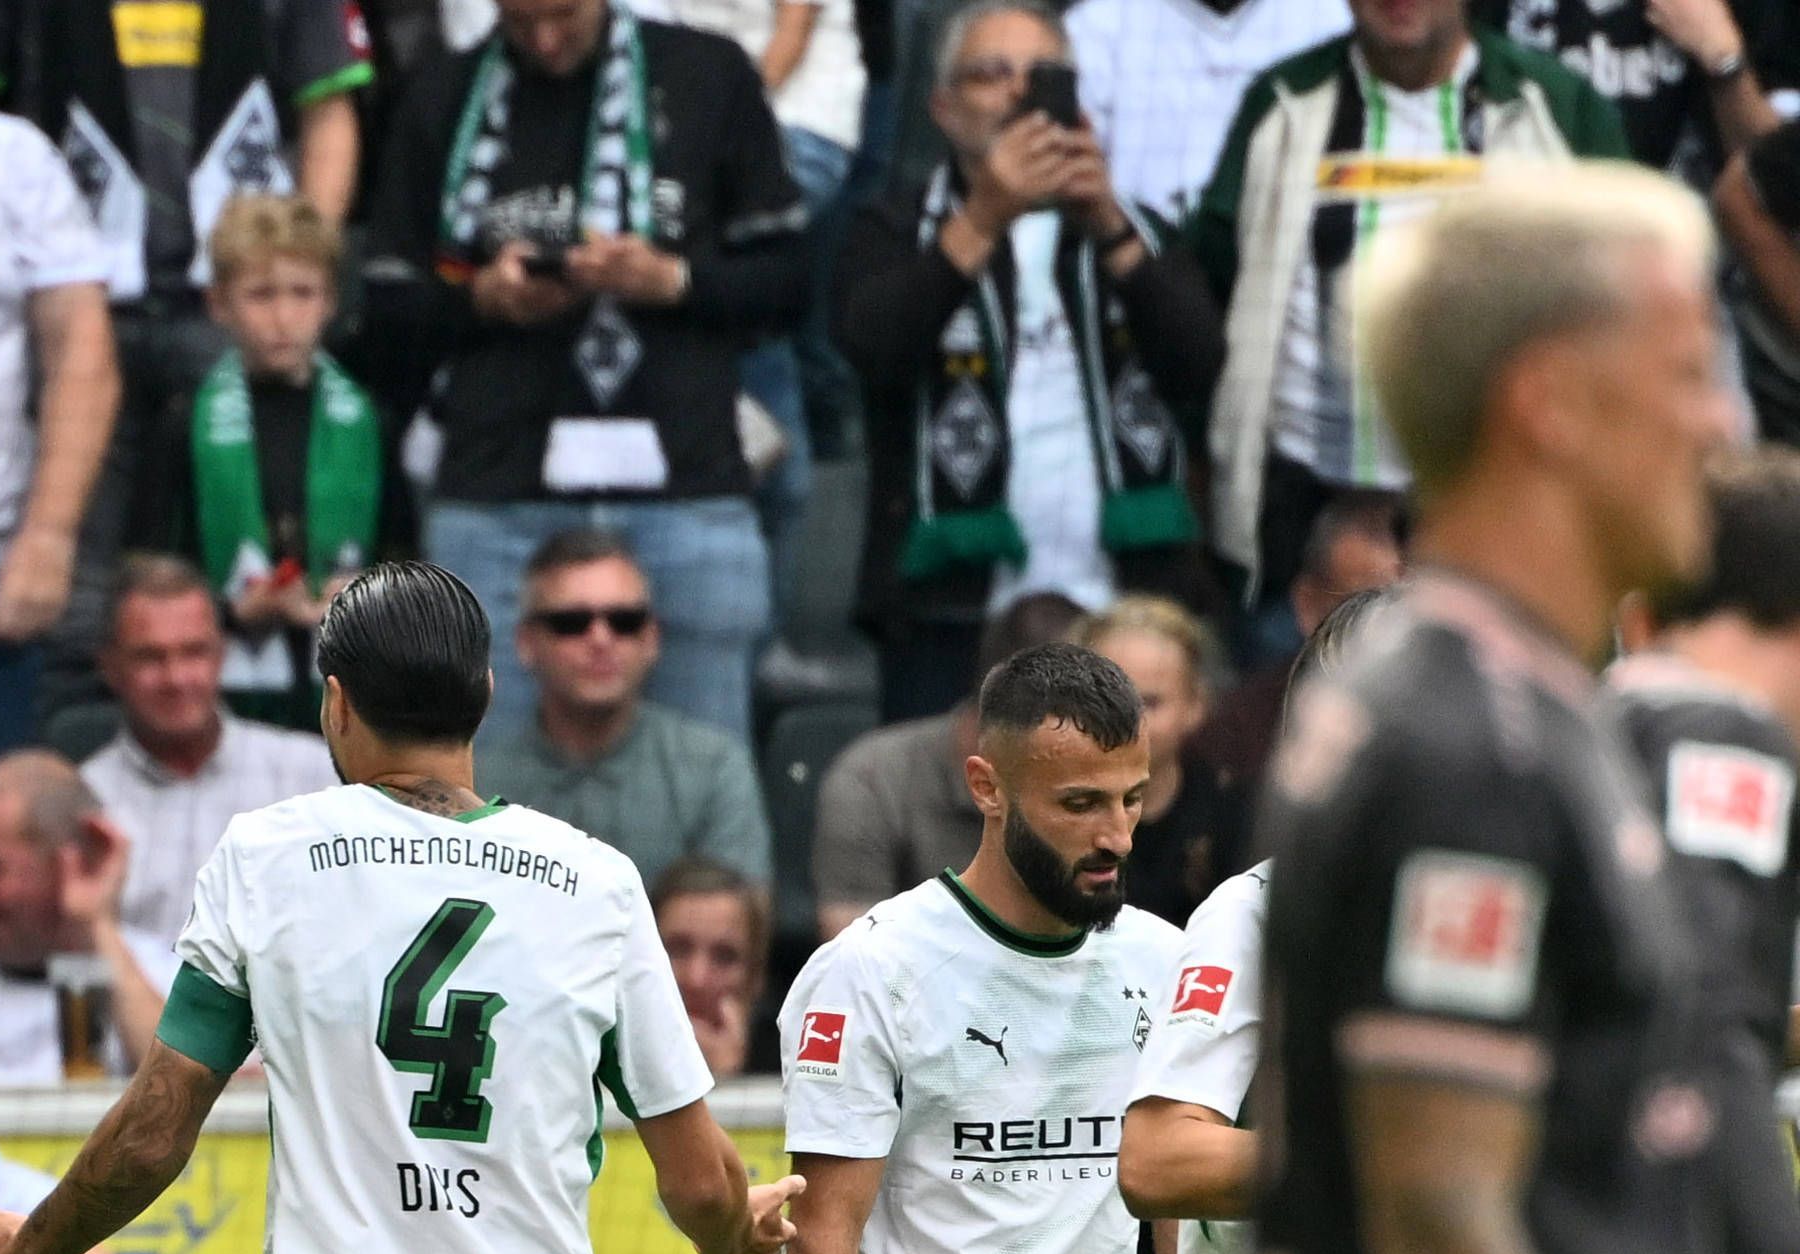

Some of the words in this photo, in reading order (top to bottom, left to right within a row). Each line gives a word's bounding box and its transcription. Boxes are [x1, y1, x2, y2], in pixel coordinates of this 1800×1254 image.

[309, 833, 579, 897] MÖNCHENGLADBACH
[375, 897, 509, 1144] 4
[794, 1065, 838, 1077] DESLIGA
[953, 1116, 1125, 1152] REUT
